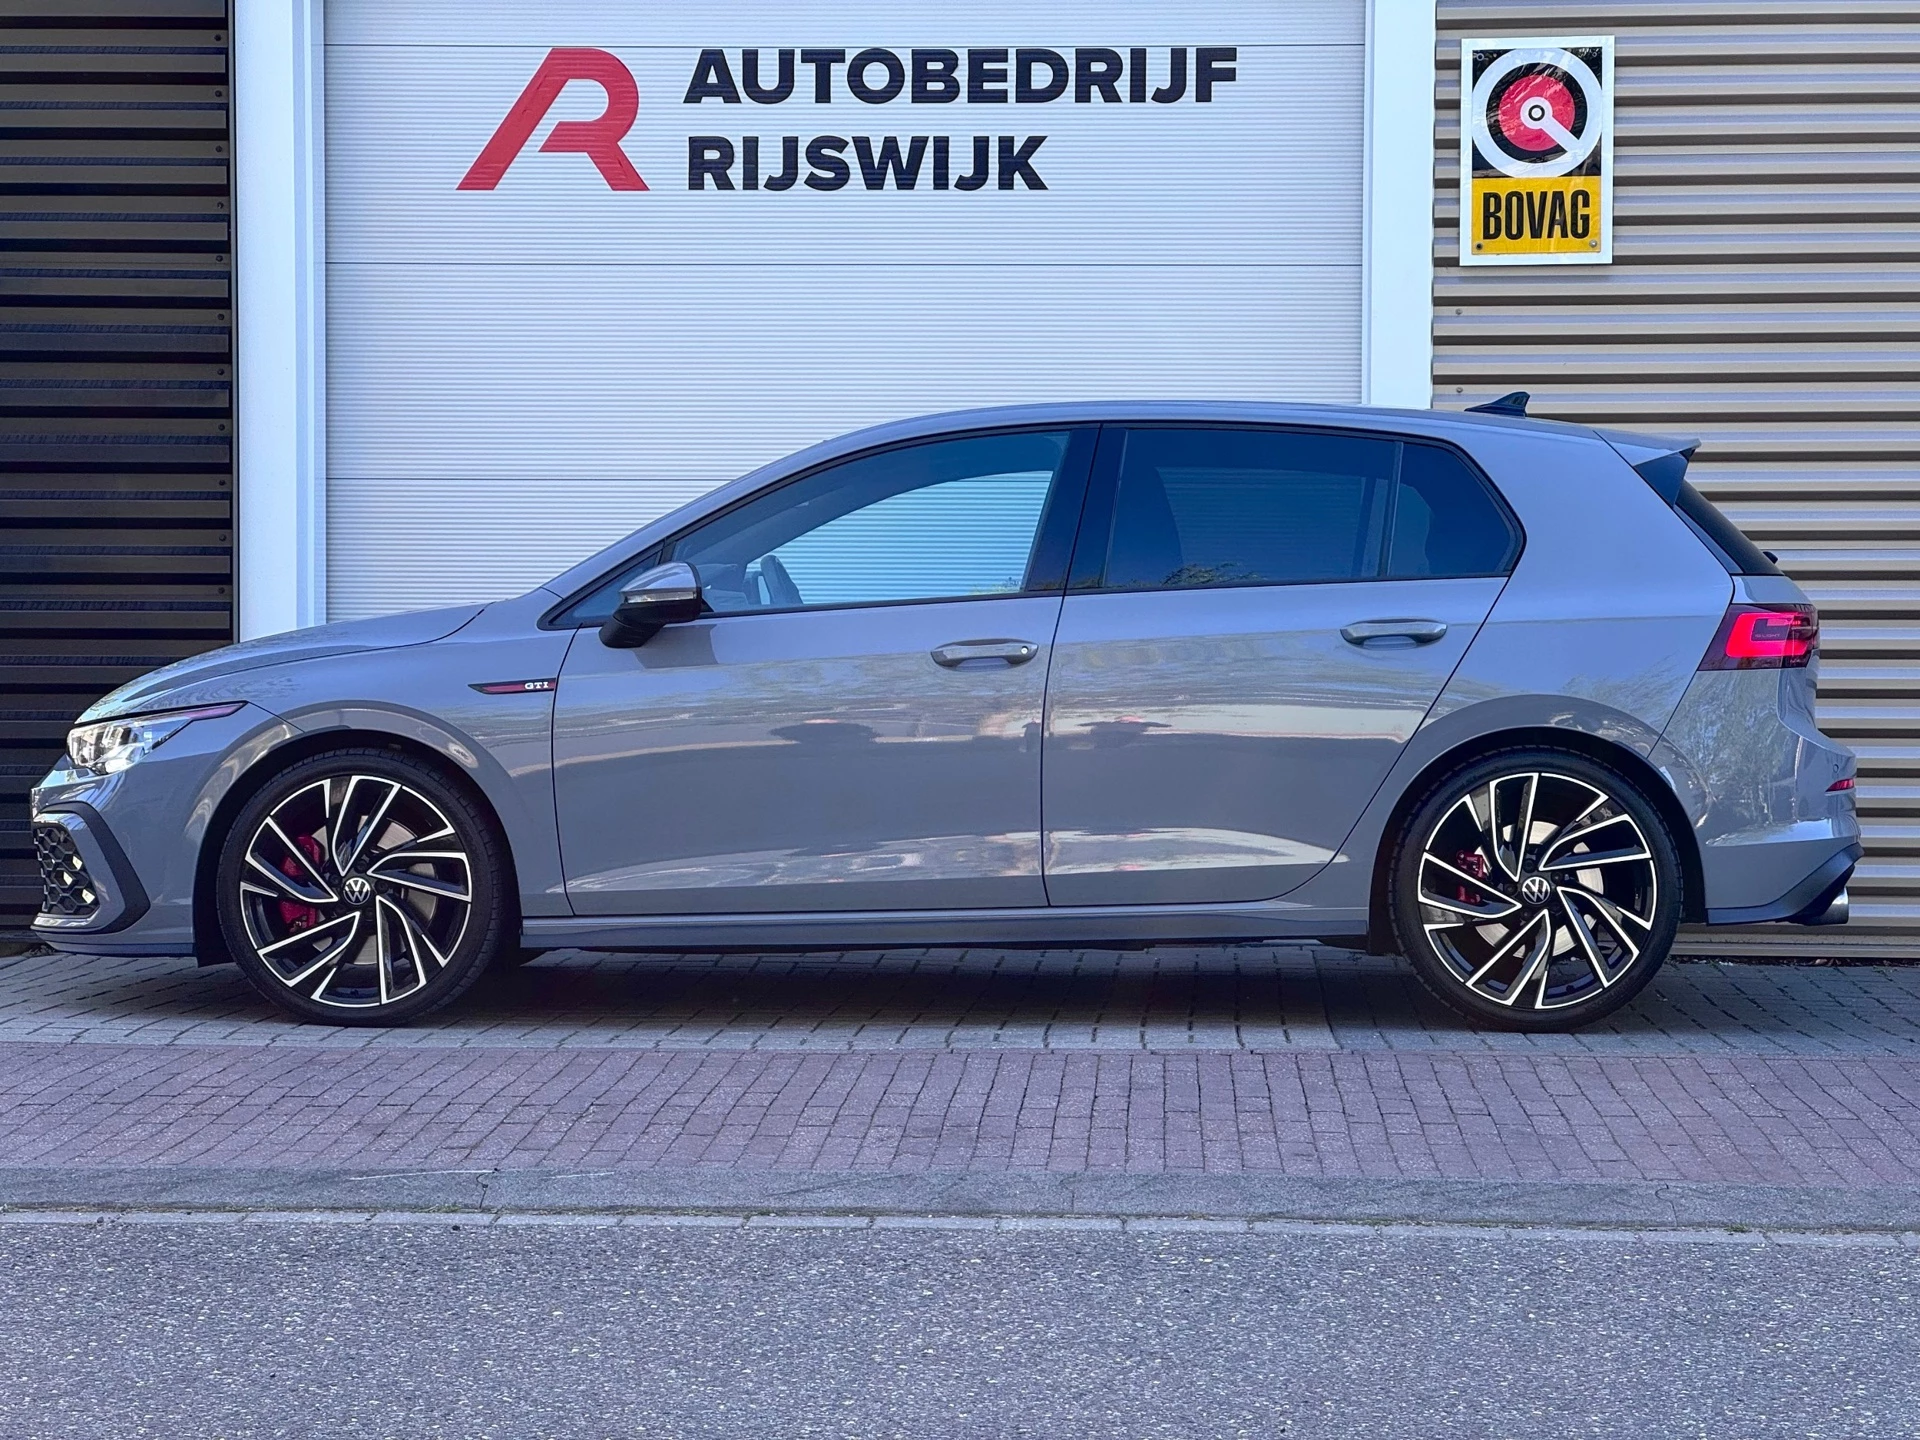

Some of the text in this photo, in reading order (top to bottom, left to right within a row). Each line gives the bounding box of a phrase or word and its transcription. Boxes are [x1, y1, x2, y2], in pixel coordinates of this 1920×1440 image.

[684, 47, 1238, 105] AUTOBEDRIJF
[688, 136, 1049, 192] RIJSWIJK
[1483, 190, 1590, 240] BOVAG
[524, 681, 549, 690] GTI
